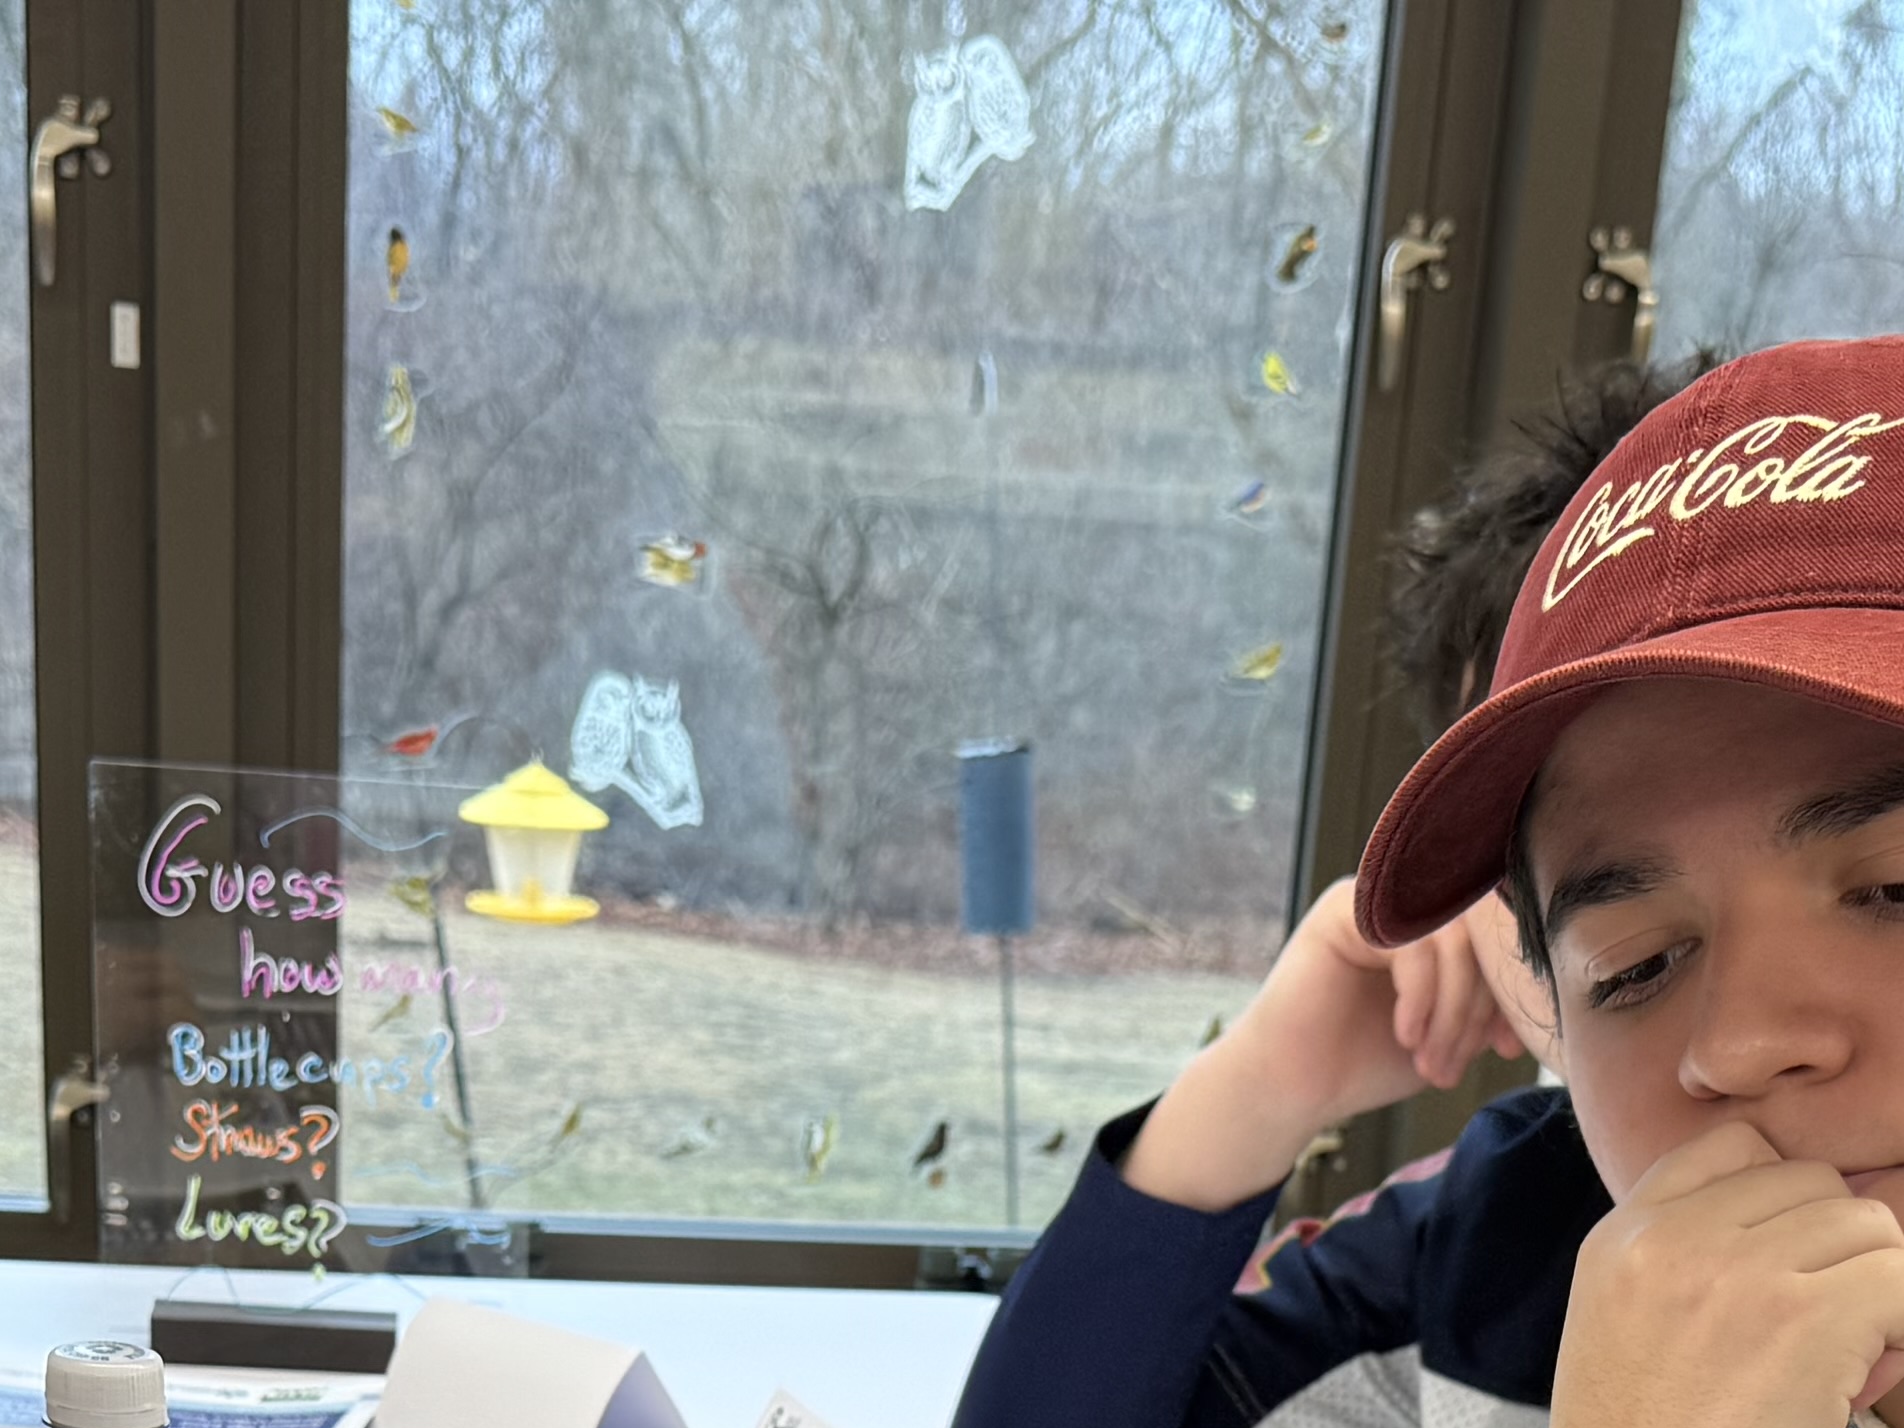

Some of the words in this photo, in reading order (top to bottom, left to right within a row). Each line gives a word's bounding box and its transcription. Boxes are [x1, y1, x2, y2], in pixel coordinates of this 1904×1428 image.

[138, 793, 346, 922] Guess
[239, 926, 343, 999] how
[170, 1099, 340, 1181] Straws?
[175, 1173, 347, 1283] Lures?
